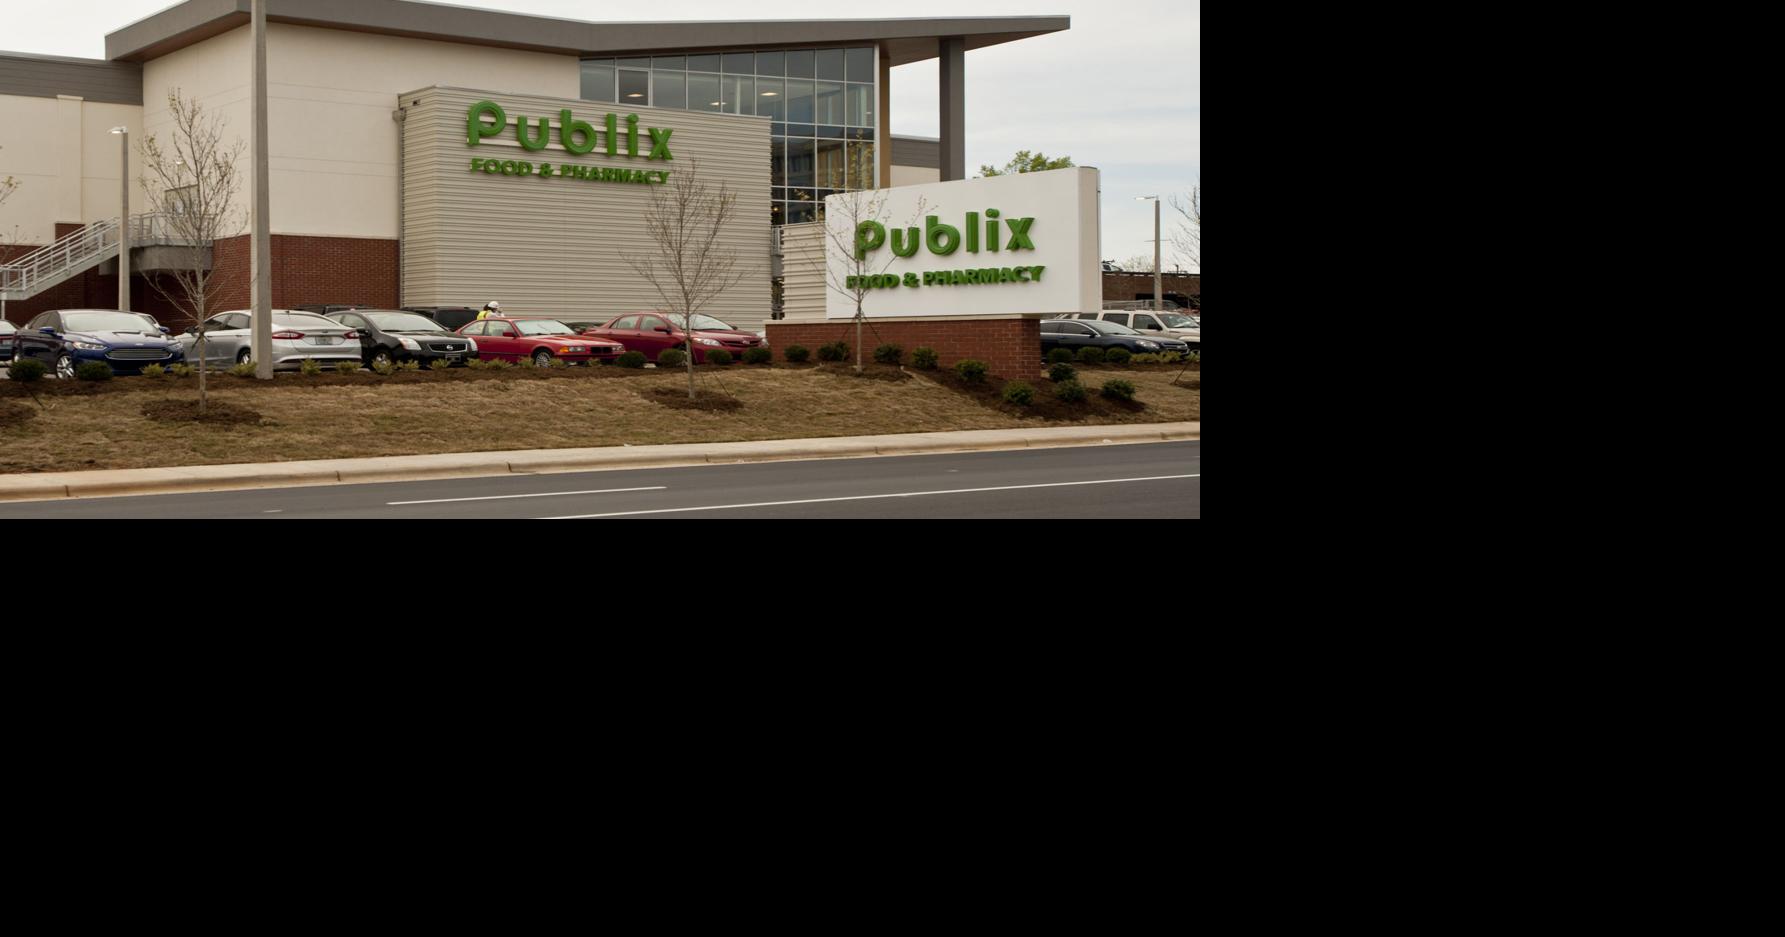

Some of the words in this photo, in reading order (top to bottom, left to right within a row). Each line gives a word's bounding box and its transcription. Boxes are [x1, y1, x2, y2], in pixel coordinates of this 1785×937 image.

[467, 100, 673, 160] Publix
[471, 157, 533, 176] FOOD
[540, 162, 554, 178] &
[560, 164, 670, 185] PHARMACY
[855, 208, 1035, 262] Publix
[846, 272, 900, 290] FOOD
[902, 272, 920, 288] &
[923, 264, 1046, 287] PHARMACY
